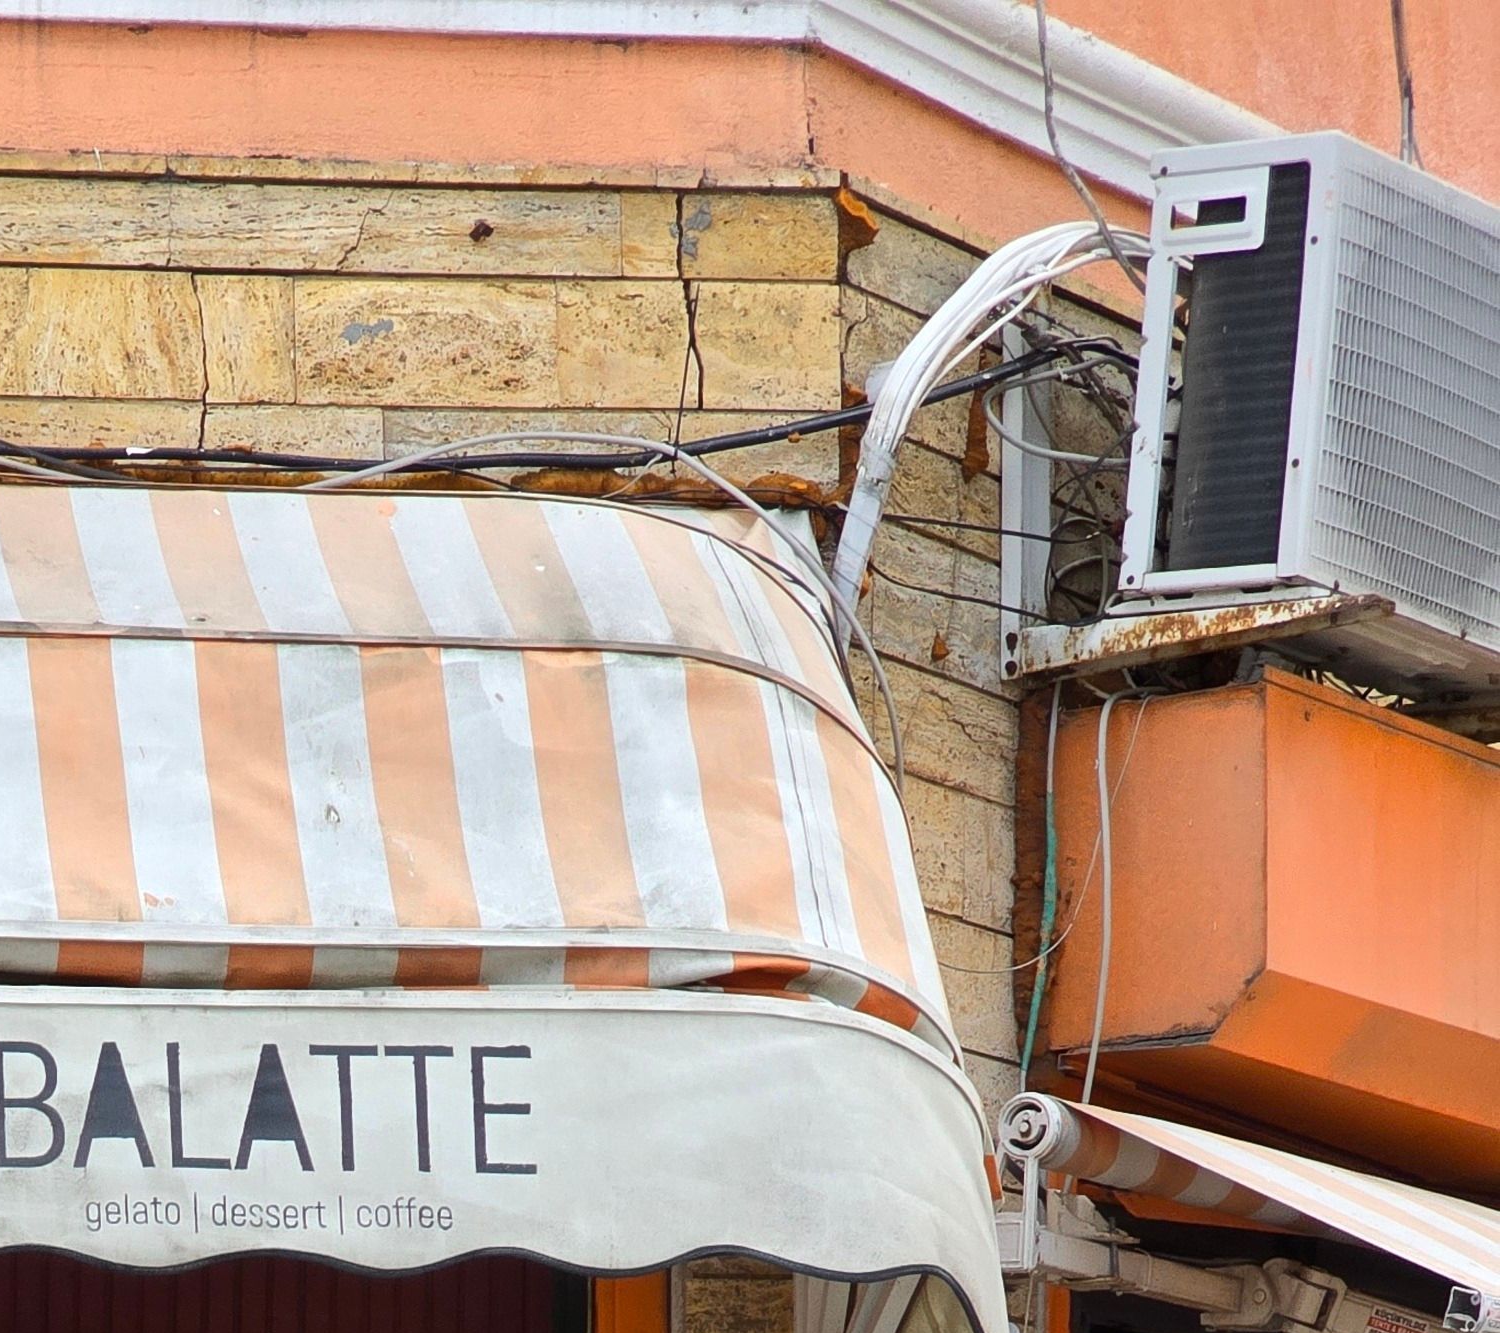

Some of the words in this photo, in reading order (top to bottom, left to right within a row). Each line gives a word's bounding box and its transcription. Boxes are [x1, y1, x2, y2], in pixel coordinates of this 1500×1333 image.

[85, 1193, 181, 1233] gelato
[211, 1196, 327, 1230] dessert
[356, 1196, 454, 1230] coffee
